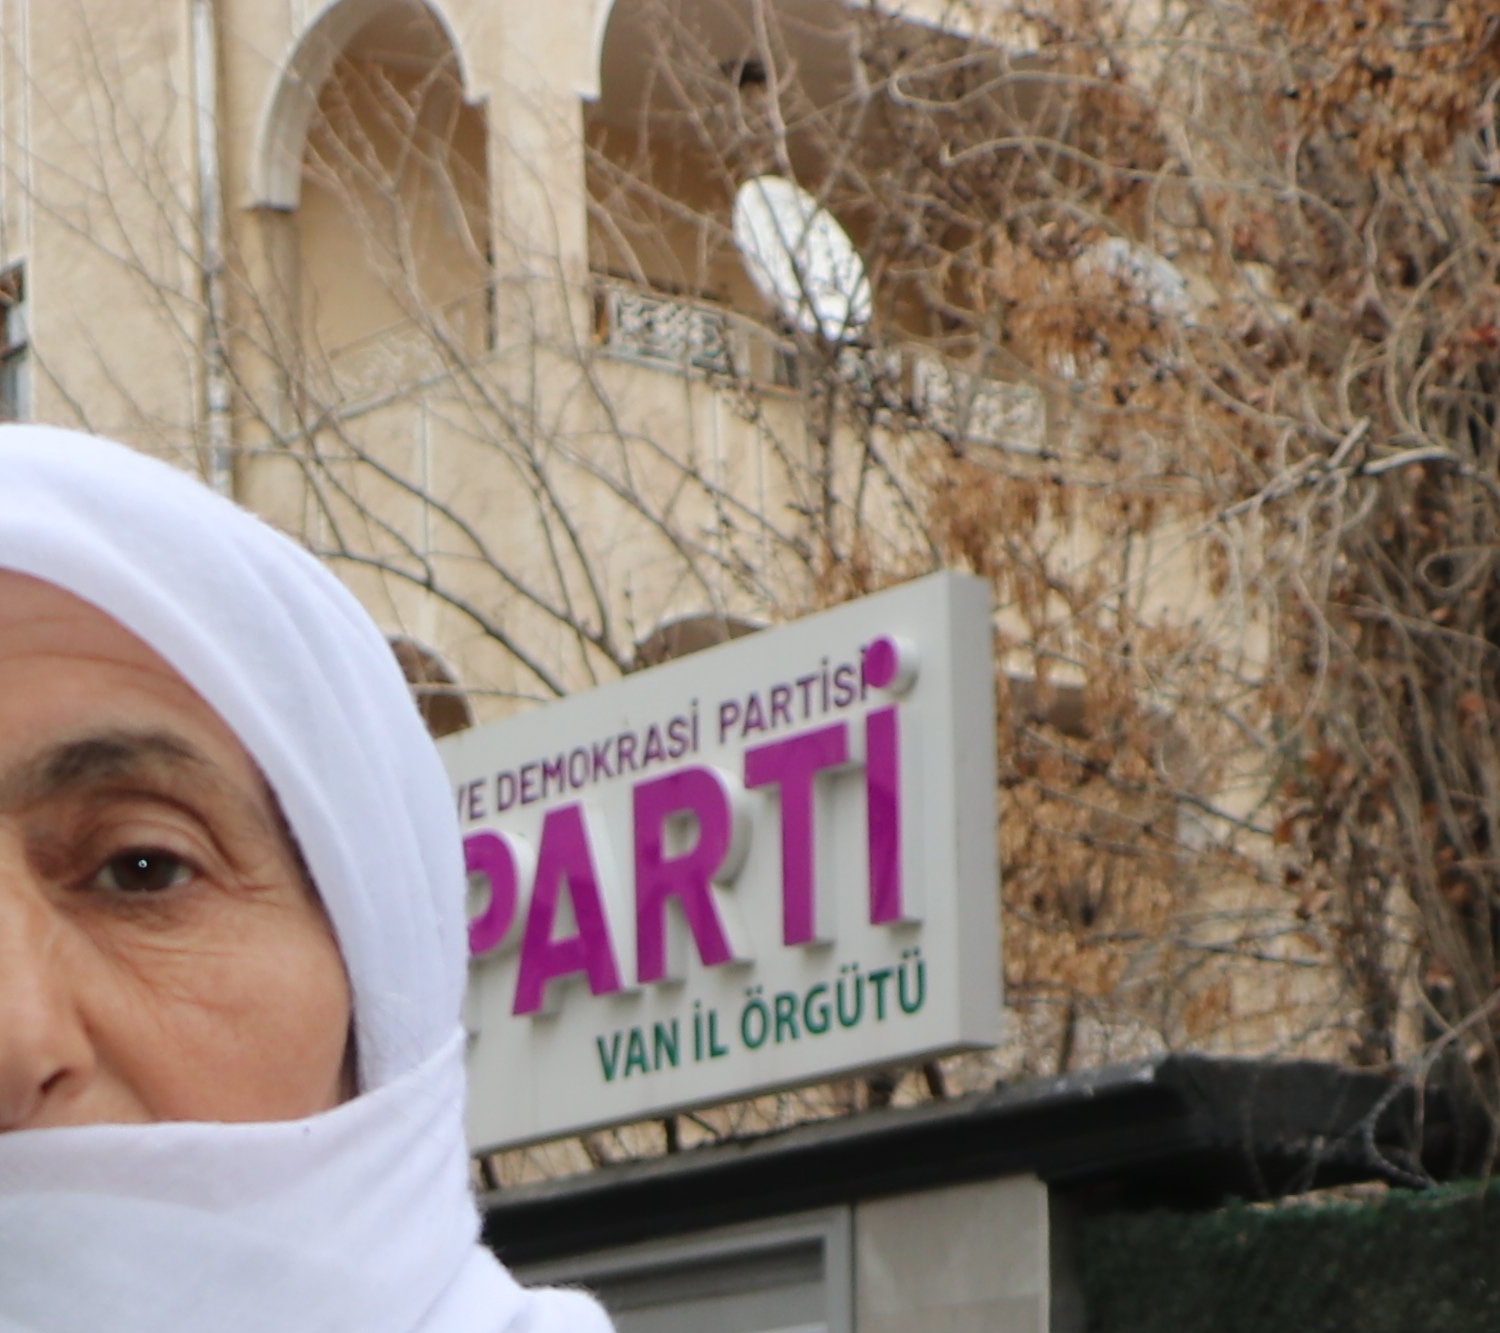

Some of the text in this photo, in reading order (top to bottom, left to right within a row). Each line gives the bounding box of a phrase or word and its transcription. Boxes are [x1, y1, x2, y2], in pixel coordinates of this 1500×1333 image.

[498, 701, 699, 814] DEMOKRASİ
[719, 643, 867, 744] PARTİSİ
[463, 635, 904, 1016] PARTİ
[597, 948, 927, 1082] VAN İL ÖRGÜTÜ
